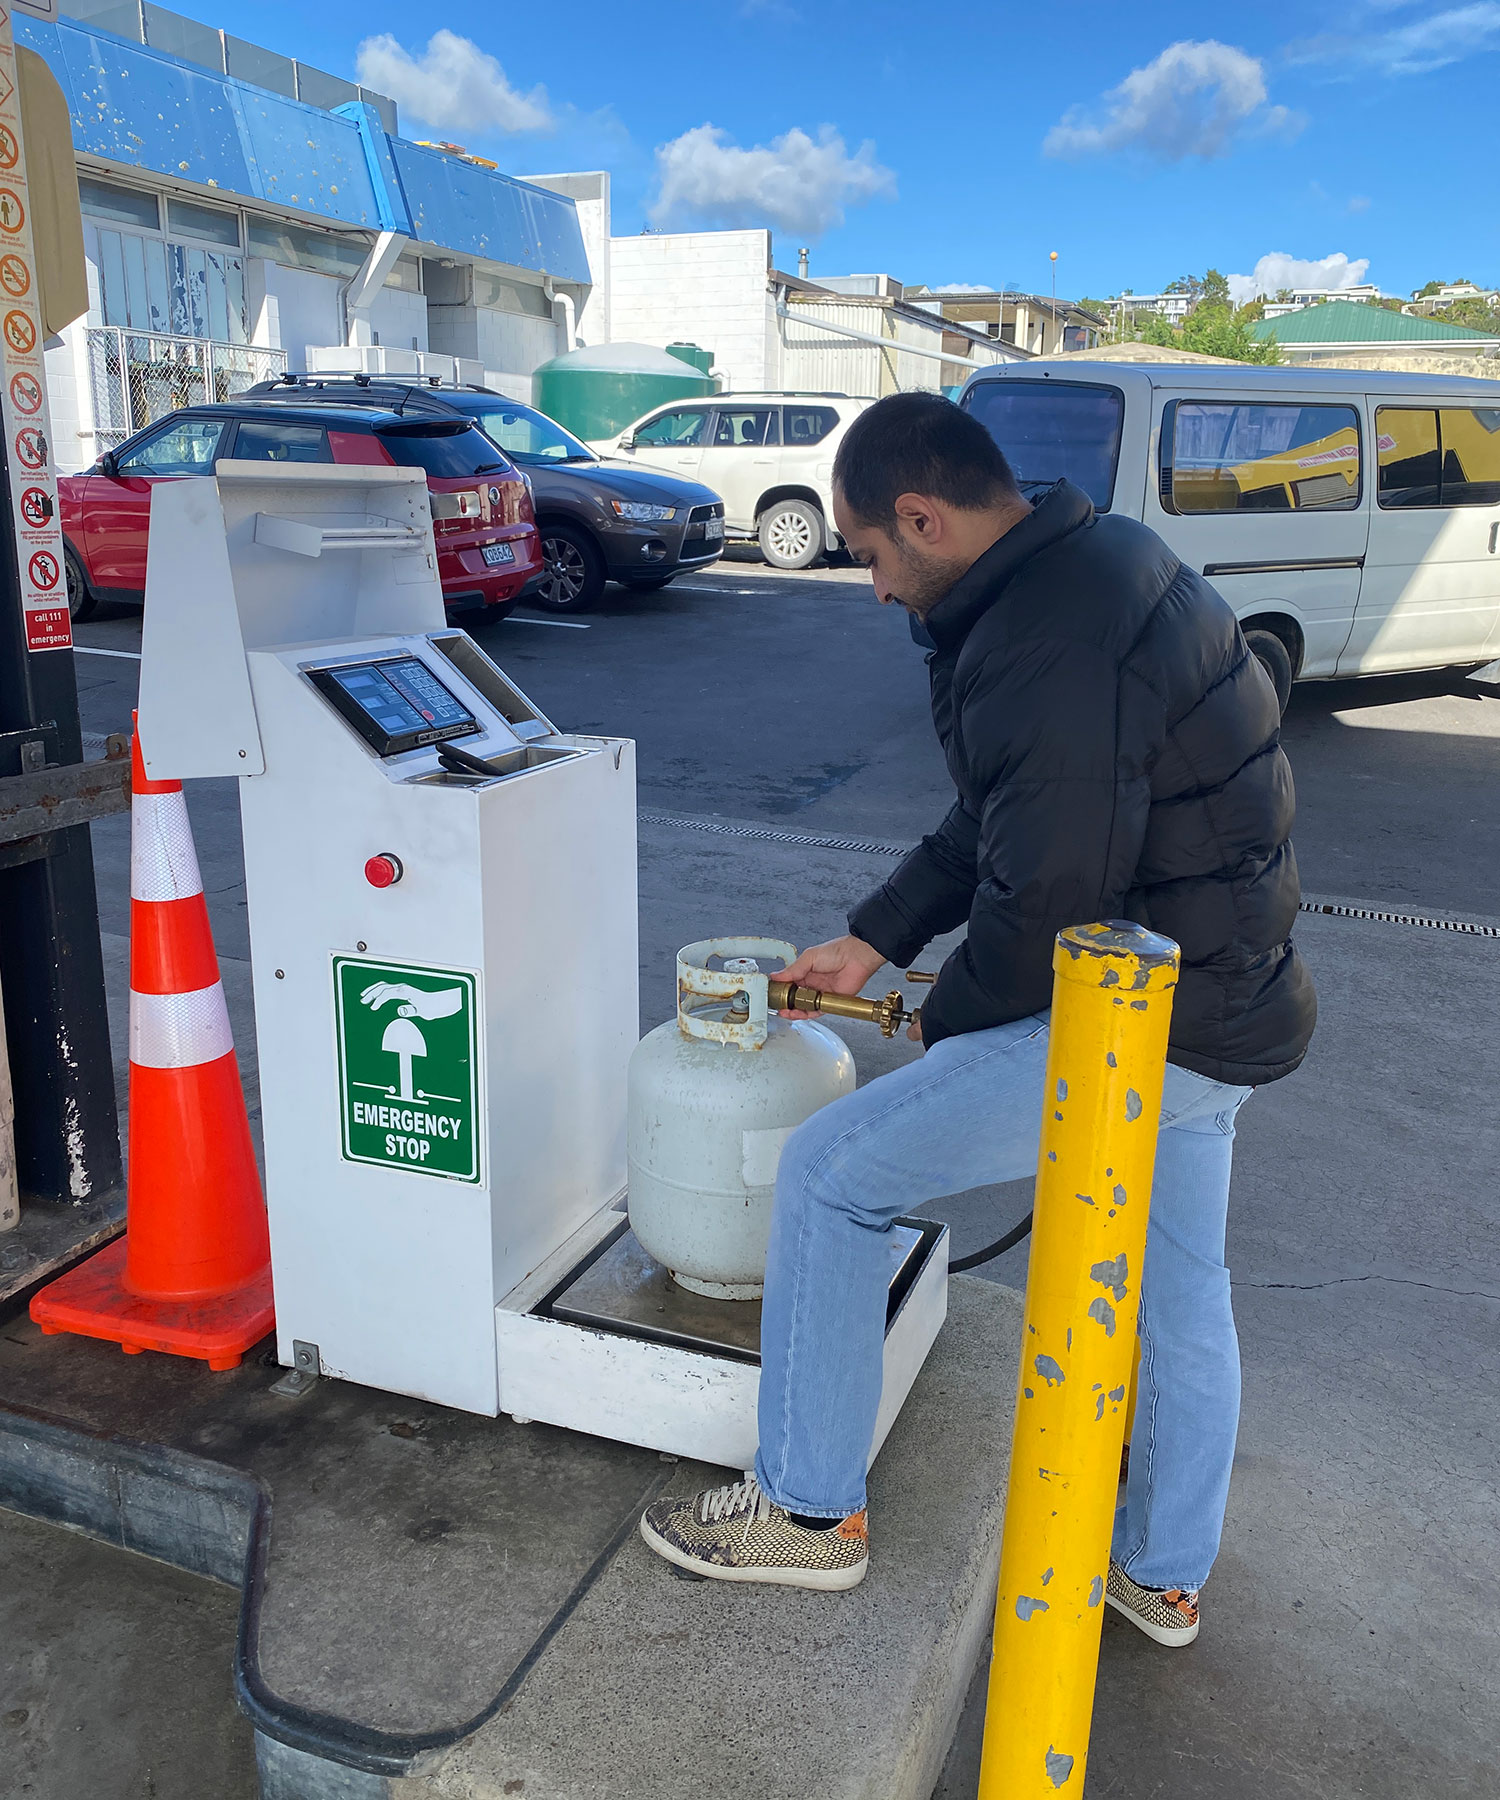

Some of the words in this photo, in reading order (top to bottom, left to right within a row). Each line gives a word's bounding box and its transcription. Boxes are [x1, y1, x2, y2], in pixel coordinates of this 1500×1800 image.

[34, 613, 48, 622] call
[49, 612, 62, 621] 111
[45, 624, 53, 632] in
[30, 634, 70, 645] emergency
[353, 1101, 462, 1140] EMERGENCY
[385, 1133, 431, 1161] STOP
